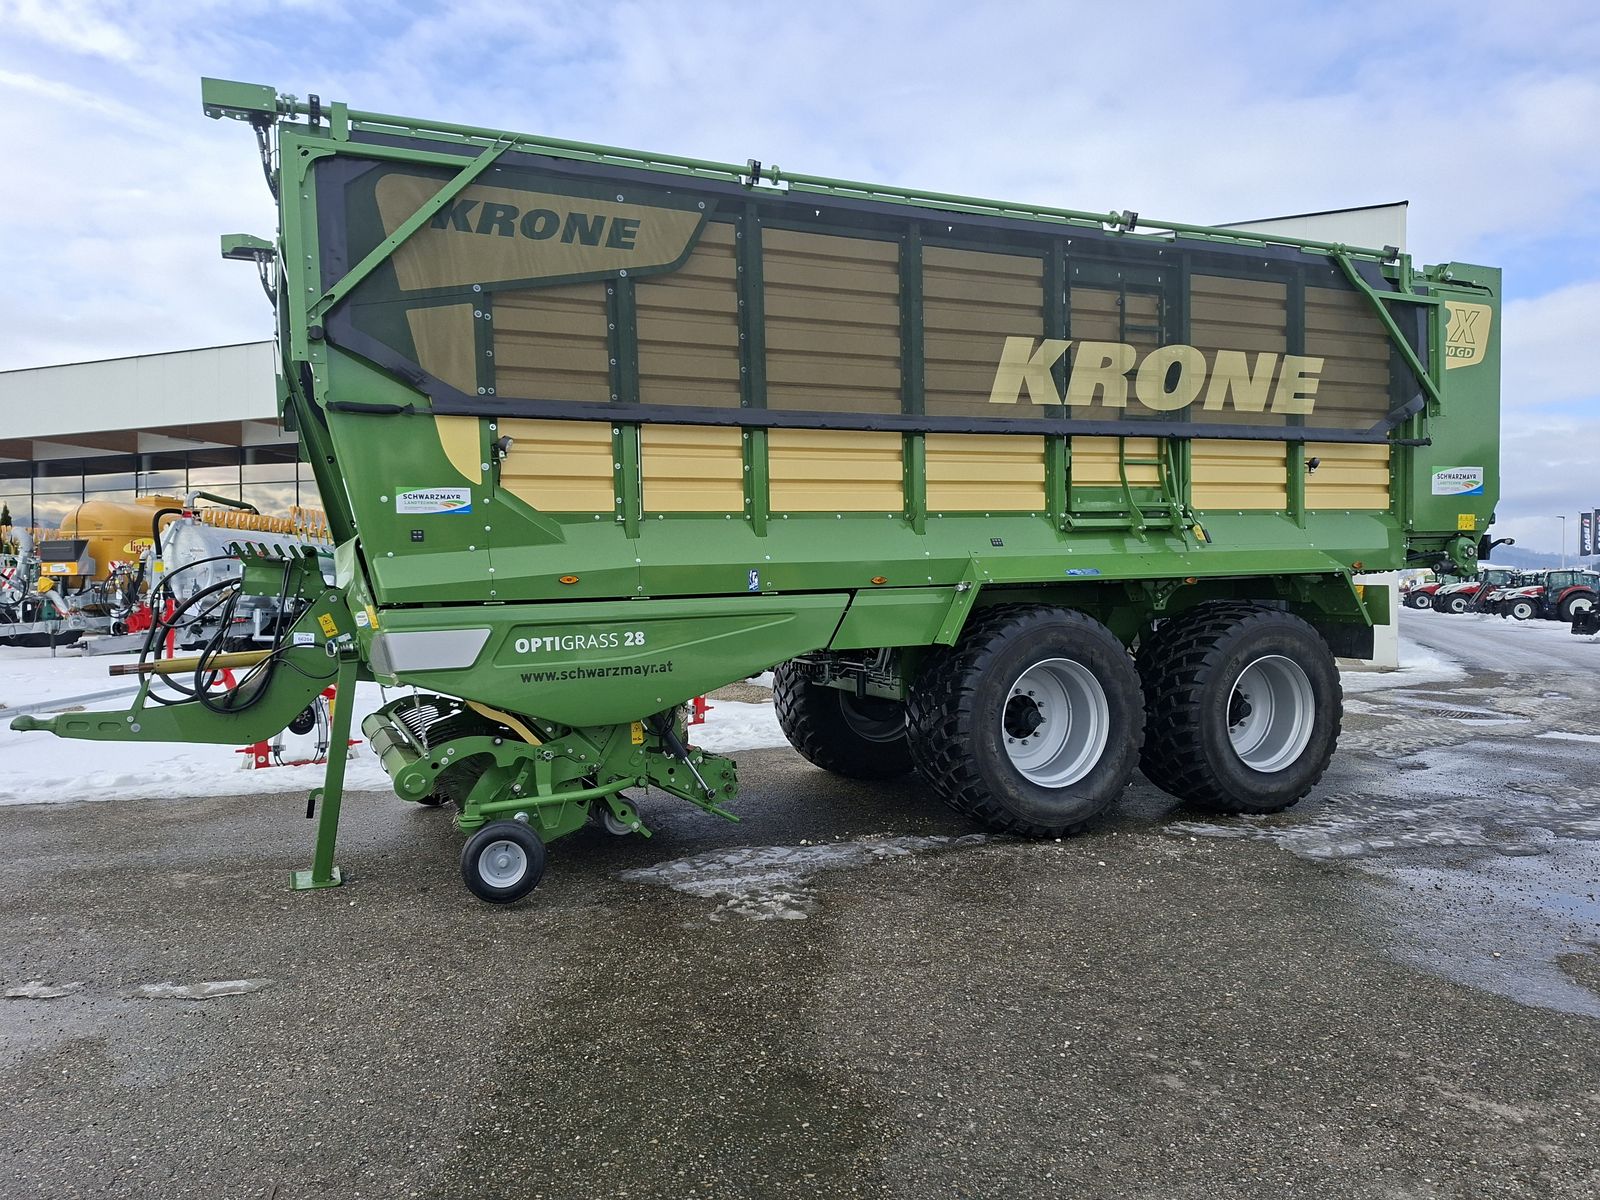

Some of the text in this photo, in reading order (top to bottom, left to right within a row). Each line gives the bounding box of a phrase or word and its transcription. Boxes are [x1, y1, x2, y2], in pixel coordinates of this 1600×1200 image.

[430, 199, 641, 250] KRONE
[1456, 346, 1473, 358] GD
[989, 336, 1325, 415] KRONE
[1584, 527, 1592, 551] CASE
[515, 631, 645, 653] OPTIGRASS 28
[520, 660, 673, 683] www.schwarzmayr.at
